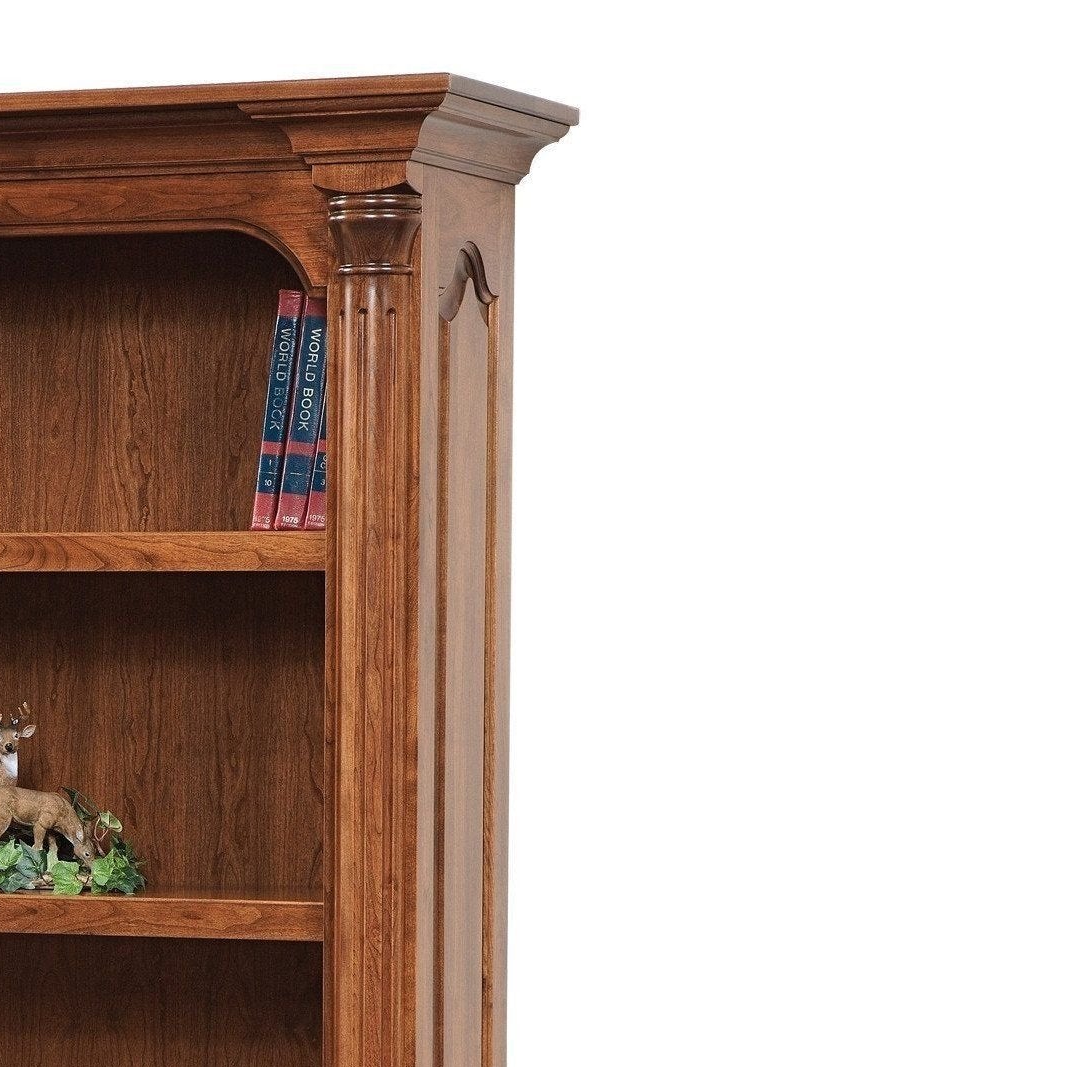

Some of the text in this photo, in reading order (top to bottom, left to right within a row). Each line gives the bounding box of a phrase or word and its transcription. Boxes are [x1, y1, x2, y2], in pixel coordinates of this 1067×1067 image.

[276, 328, 291, 381] WORLD
[298, 328, 322, 431] WORLD BOOK
